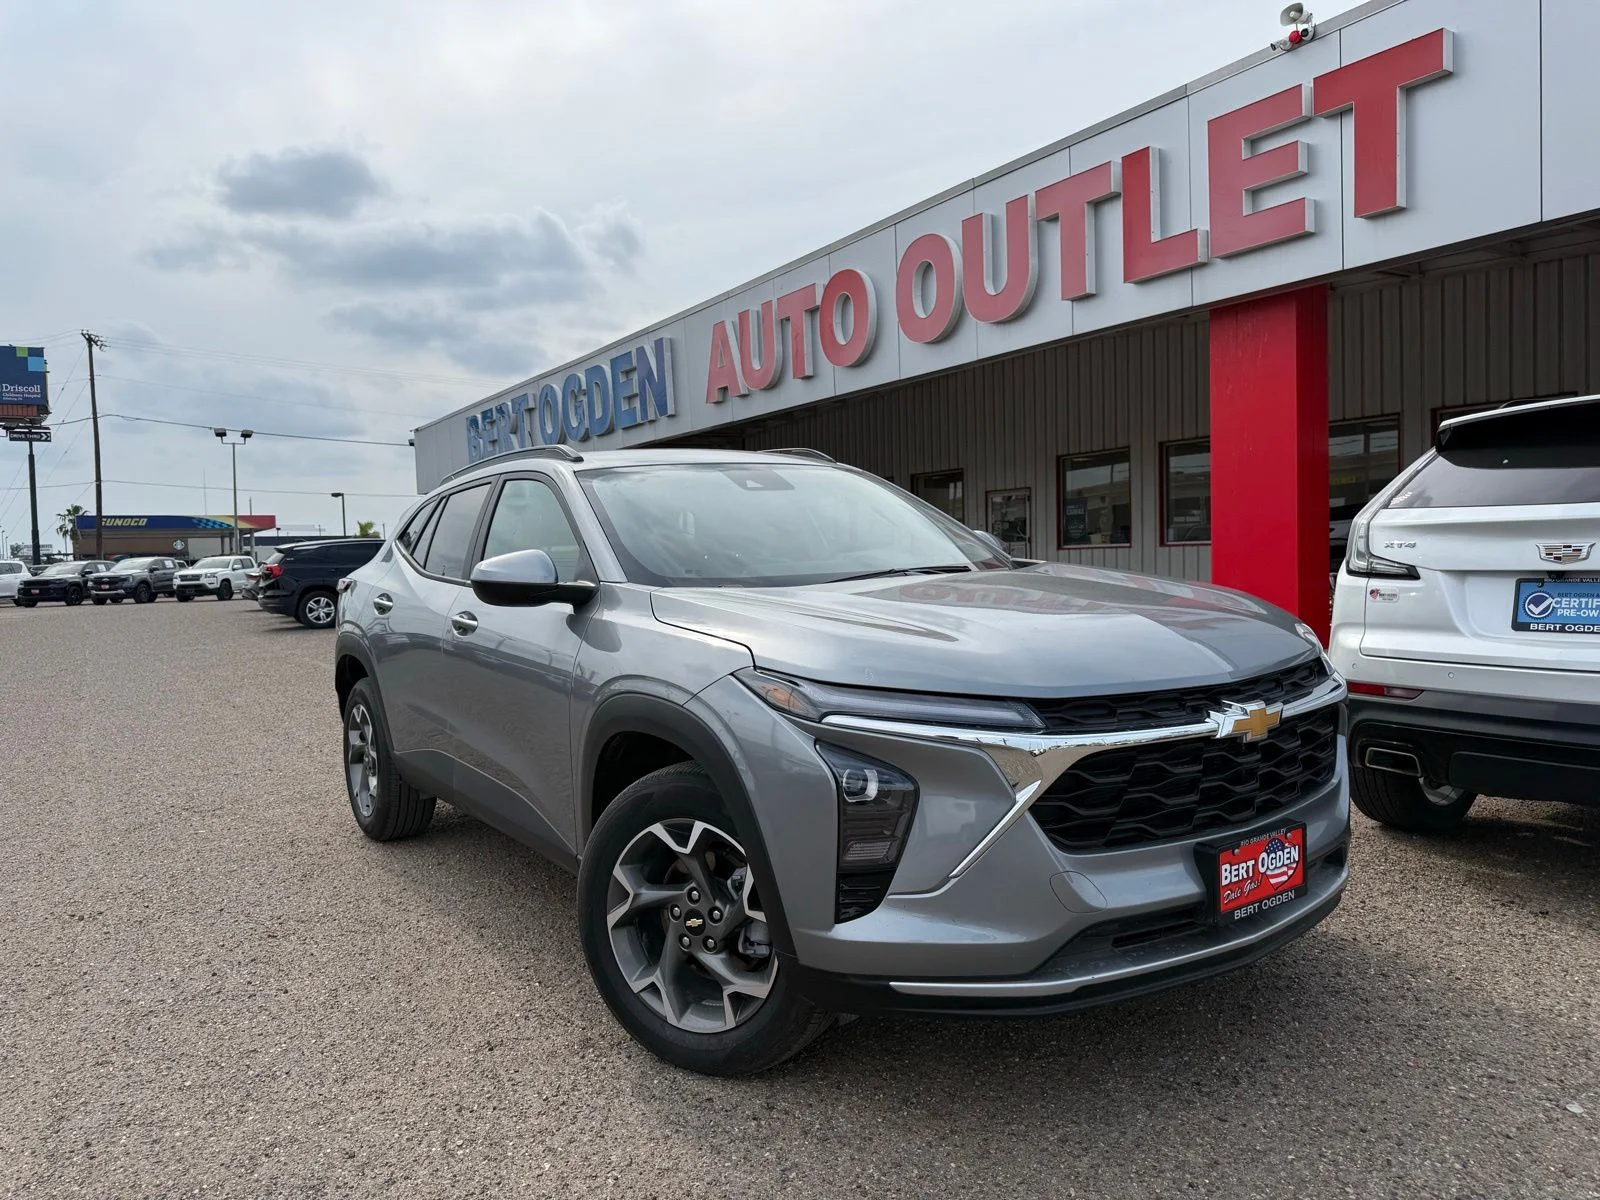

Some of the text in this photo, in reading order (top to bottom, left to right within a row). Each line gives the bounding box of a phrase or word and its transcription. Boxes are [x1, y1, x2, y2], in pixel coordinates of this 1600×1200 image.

[466, 28, 1453, 463] BERT OGDEN AUTO OUTLET
[2, 383, 41, 392] Driscoll
[1384, 540, 1417, 549] XT4
[1557, 609, 1600, 617] PRE-OW
[1530, 623, 1562, 631] BERT
[1221, 845, 1299, 886] BERT OGDEN
[1223, 889, 1242, 904] Dale
[1234, 890, 1295, 920] BERT OGDEN
